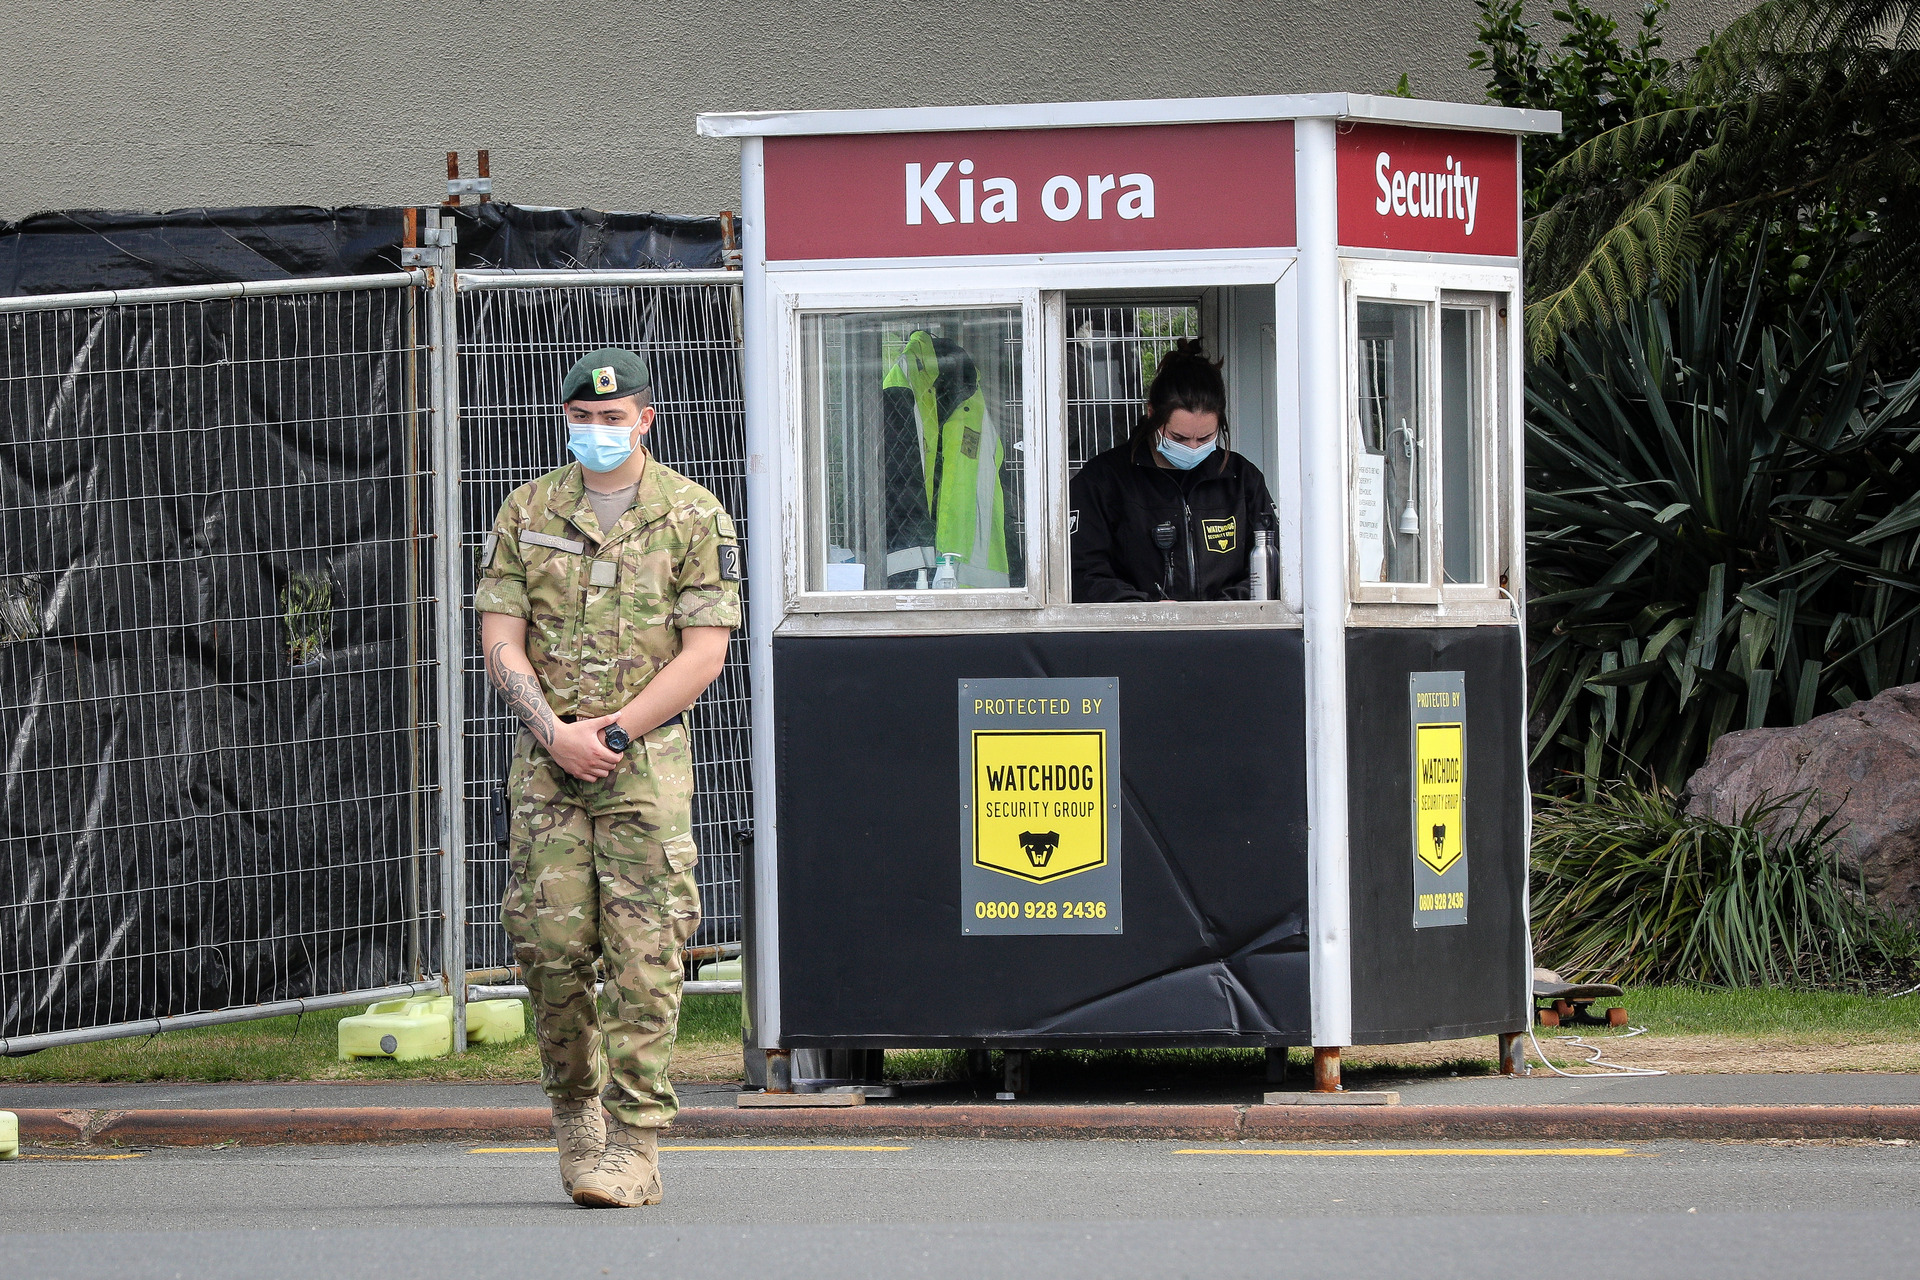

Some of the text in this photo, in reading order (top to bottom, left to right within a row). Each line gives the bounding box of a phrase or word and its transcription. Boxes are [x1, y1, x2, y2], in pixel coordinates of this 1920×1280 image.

[905, 158, 1155, 225] Kia ora
[1375, 151, 1479, 236] Security
[725, 549, 738, 575] 2
[974, 698, 1103, 715] PROTECTED BY
[1416, 692, 1461, 708] PROTECTED BY
[986, 765, 1094, 792] WATCHDOG
[1421, 757, 1459, 785] WATCHDOG
[986, 801, 1095, 818] SECURITY GROUP
[1421, 793, 1459, 811] SECURITY GROUP
[975, 901, 1107, 919] 0800 928 2436
[1419, 891, 1464, 912] 0800 928 2436
